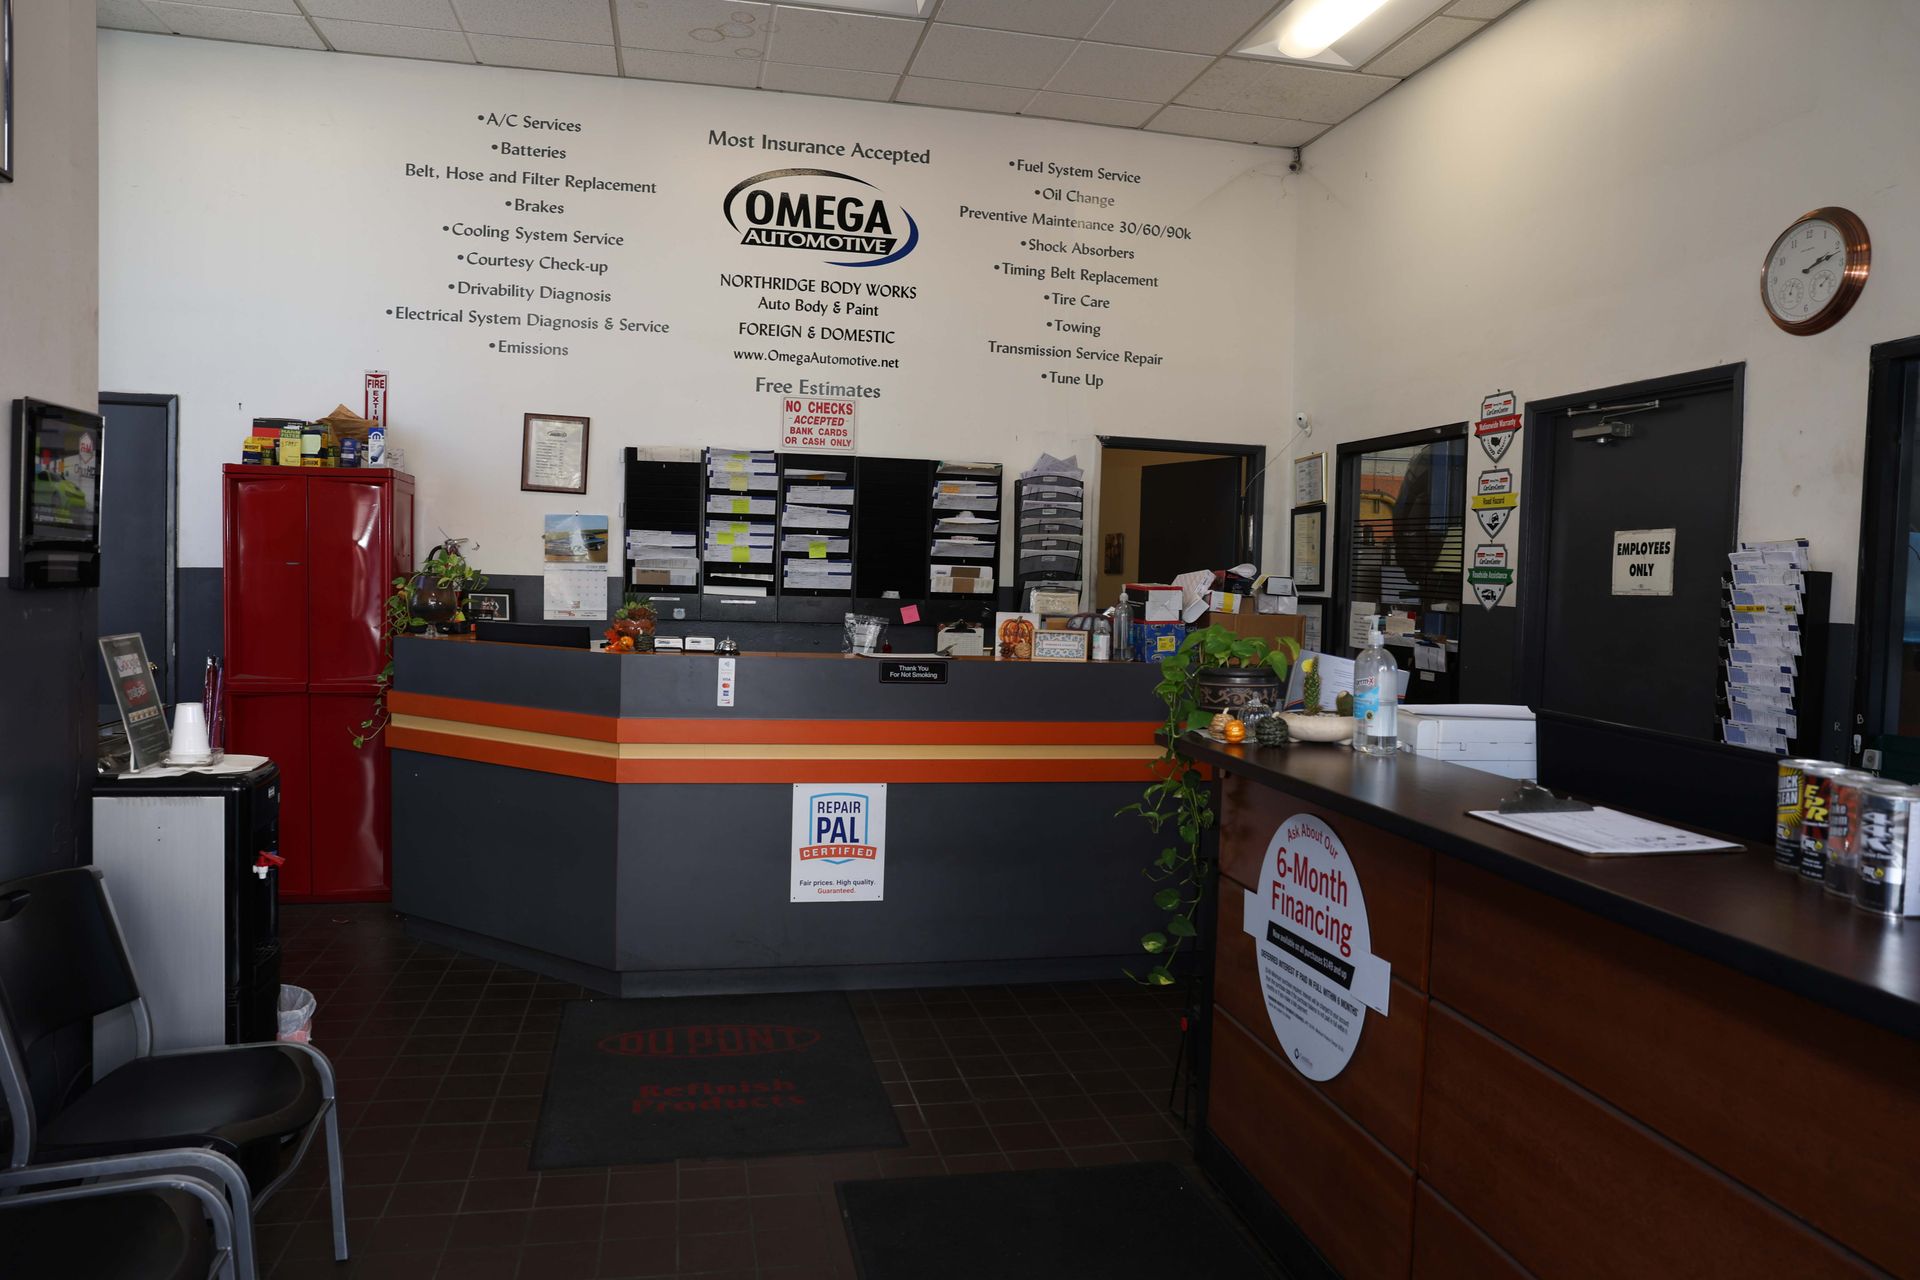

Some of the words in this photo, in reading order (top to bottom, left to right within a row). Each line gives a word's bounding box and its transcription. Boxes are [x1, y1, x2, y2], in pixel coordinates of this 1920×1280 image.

[487, 112, 518, 128] A/C
[523, 116, 582, 132] Services
[501, 142, 566, 159] Batteries
[708, 130, 755, 149] Most
[762, 134, 845, 157] Insurance
[851, 139, 930, 165] Accepted
[405, 163, 439, 179] Belt,
[446, 166, 484, 181] Hose
[489, 171, 516, 184] and
[523, 172, 560, 187] Filter
[565, 175, 656, 193] Replacement
[1017, 159, 1044, 174] Fuel
[1048, 161, 1093, 180] System
[1098, 165, 1141, 183] Service
[515, 199, 564, 214] Brakes
[1043, 187, 1062, 201] Oil
[1067, 188, 1115, 208] Change
[745, 188, 892, 235] OMEGA
[960, 205, 1027, 224] Preventive
[1032, 212, 1114, 232] Maintenance
[1119, 219, 1191, 241] 30/60/90k
[452, 223, 509, 241] Cooling
[516, 226, 568, 243] System
[573, 230, 624, 246] Service
[745, 230, 888, 253] AUTOMOTIVE
[1028, 238, 1067, 254] Shock
[1072, 242, 1134, 260] Absorbers
[466, 252, 534, 271] Courtesy
[540, 256, 608, 276] Check-up
[1002, 262, 1045, 280] Timing
[1051, 265, 1076, 280] Belt
[1081, 268, 1158, 288] Replacement
[458, 281, 534, 300] Drivability
[540, 286, 612, 303] Diagnosis
[720, 273, 816, 294] NORTHRIDGE
[820, 278, 863, 296] BODY
[866, 280, 917, 299] WORKS
[758, 297, 790, 313] Auto
[795, 298, 828, 316] Body
[832, 301, 841, 315] &
[846, 302, 879, 317] Paint
[1052, 292, 1077, 306] Tire
[1082, 294, 1110, 309] Care
[396, 307, 463, 322] Electrical
[468, 310, 521, 326] System
[527, 314, 599, 330] Diagnosis
[604, 318, 614, 330] &
[619, 318, 670, 333] Service
[1054, 319, 1101, 337] Towing
[739, 322, 802, 339] FOREIGN
[808, 325, 816, 340] &
[821, 326, 895, 344] DOMESTIC
[499, 340, 568, 356] Emissions
[734, 348, 899, 369] www.OmegaAutomotive.net
[988, 340, 1071, 360] Transmission
[1076, 346, 1119, 363] Service
[1123, 349, 1163, 368] Repair
[368, 380, 385, 388] FIRE
[756, 377, 792, 394] Free
[799, 379, 880, 398] Estimates
[1049, 371, 1080, 386] Tune
[1084, 372, 1104, 390] Up
[786, 400, 801, 412] NO
[808, 402, 853, 415] CHECKS
[794, 415, 844, 426] ACCEPTED
[790, 426, 813, 435] BANK
[818, 428, 848, 437] CARDS
[802, 437, 825, 445] CASH
[830, 439, 852, 447] ONLY
[1617, 541, 1670, 555] EMPLOYEES
[1629, 563, 1654, 576] ONLY
[1857, 714, 1864, 724] B
[817, 801, 861, 814] REPAIR
[1805, 784, 1829, 822] EPR
[817, 816, 859, 843] PAL
[1287, 825, 1300, 842] Ask
[1301, 824, 1323, 844] About
[1324, 836, 1338, 859] Our
[803, 848, 873, 858] CERTIFIED
[836, 879, 851, 887] High
[853, 879, 875, 887] quality.
[1276, 847, 1347, 907] 6-Month
[1272, 880, 1352, 957] Financing
[1313, 978, 1322, 994] FULL
[1341, 998, 1359, 1017] MONTHS
[621, 1029, 674, 1054] DU
[688, 1026, 796, 1053] PONT
[639, 1078, 796, 1097] Refinish
[632, 1094, 808, 1114] Products
